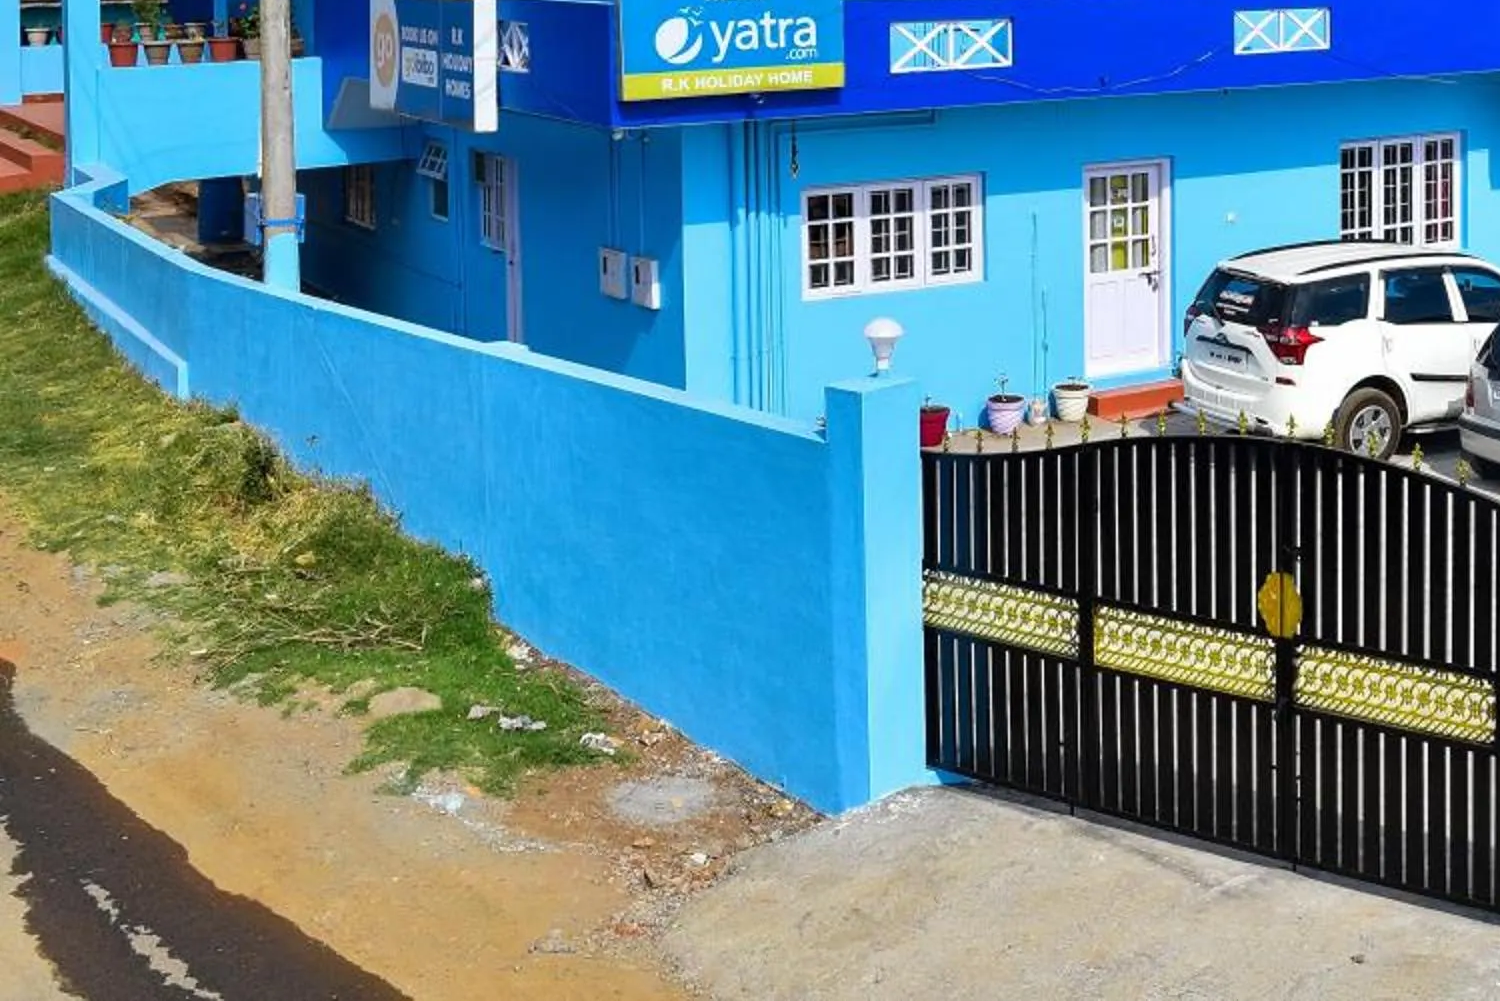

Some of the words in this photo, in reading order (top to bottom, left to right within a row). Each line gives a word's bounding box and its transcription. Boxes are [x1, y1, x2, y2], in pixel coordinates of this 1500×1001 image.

[709, 10, 818, 64] yatra
[785, 47, 819, 61] .com
[661, 78, 692, 92] R.K
[694, 73, 765, 91] HOLIDAY
[768, 69, 814, 85] HOME
